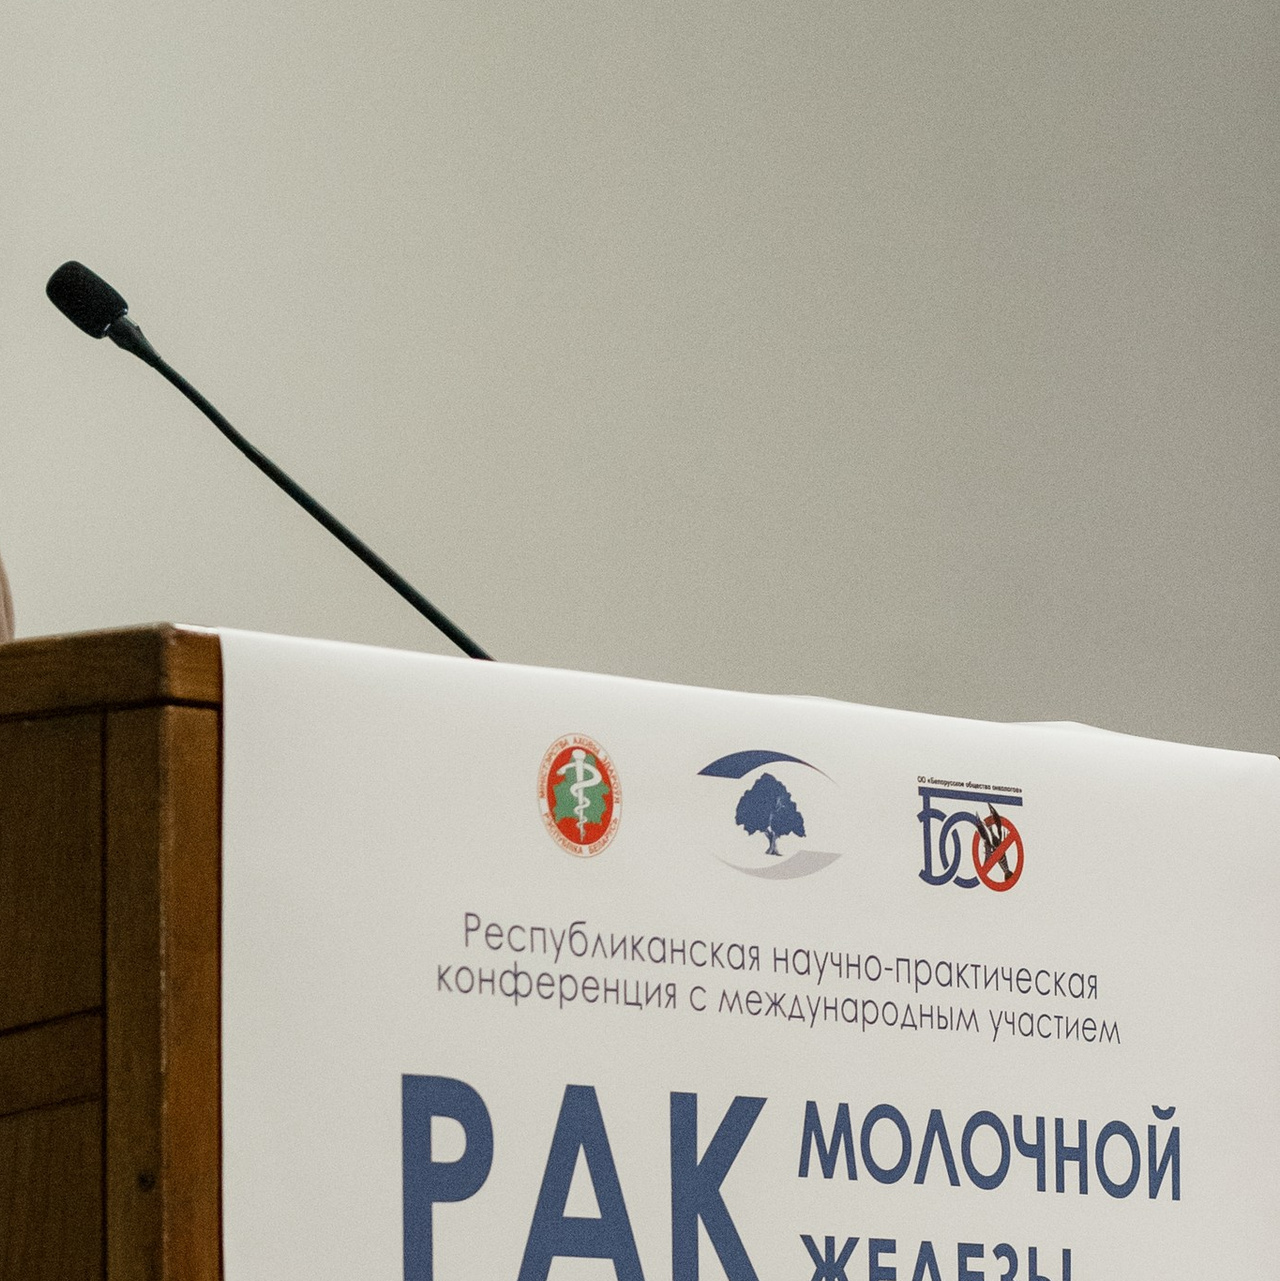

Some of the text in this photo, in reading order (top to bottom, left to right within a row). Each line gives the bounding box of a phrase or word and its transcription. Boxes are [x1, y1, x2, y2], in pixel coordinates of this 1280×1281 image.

[464, 911, 1099, 1001] Республиканская научно-практическая
[436, 961, 1121, 1044] конференция с международным участием
[797, 1100, 1182, 1202] МОЛОЧНОЙ
